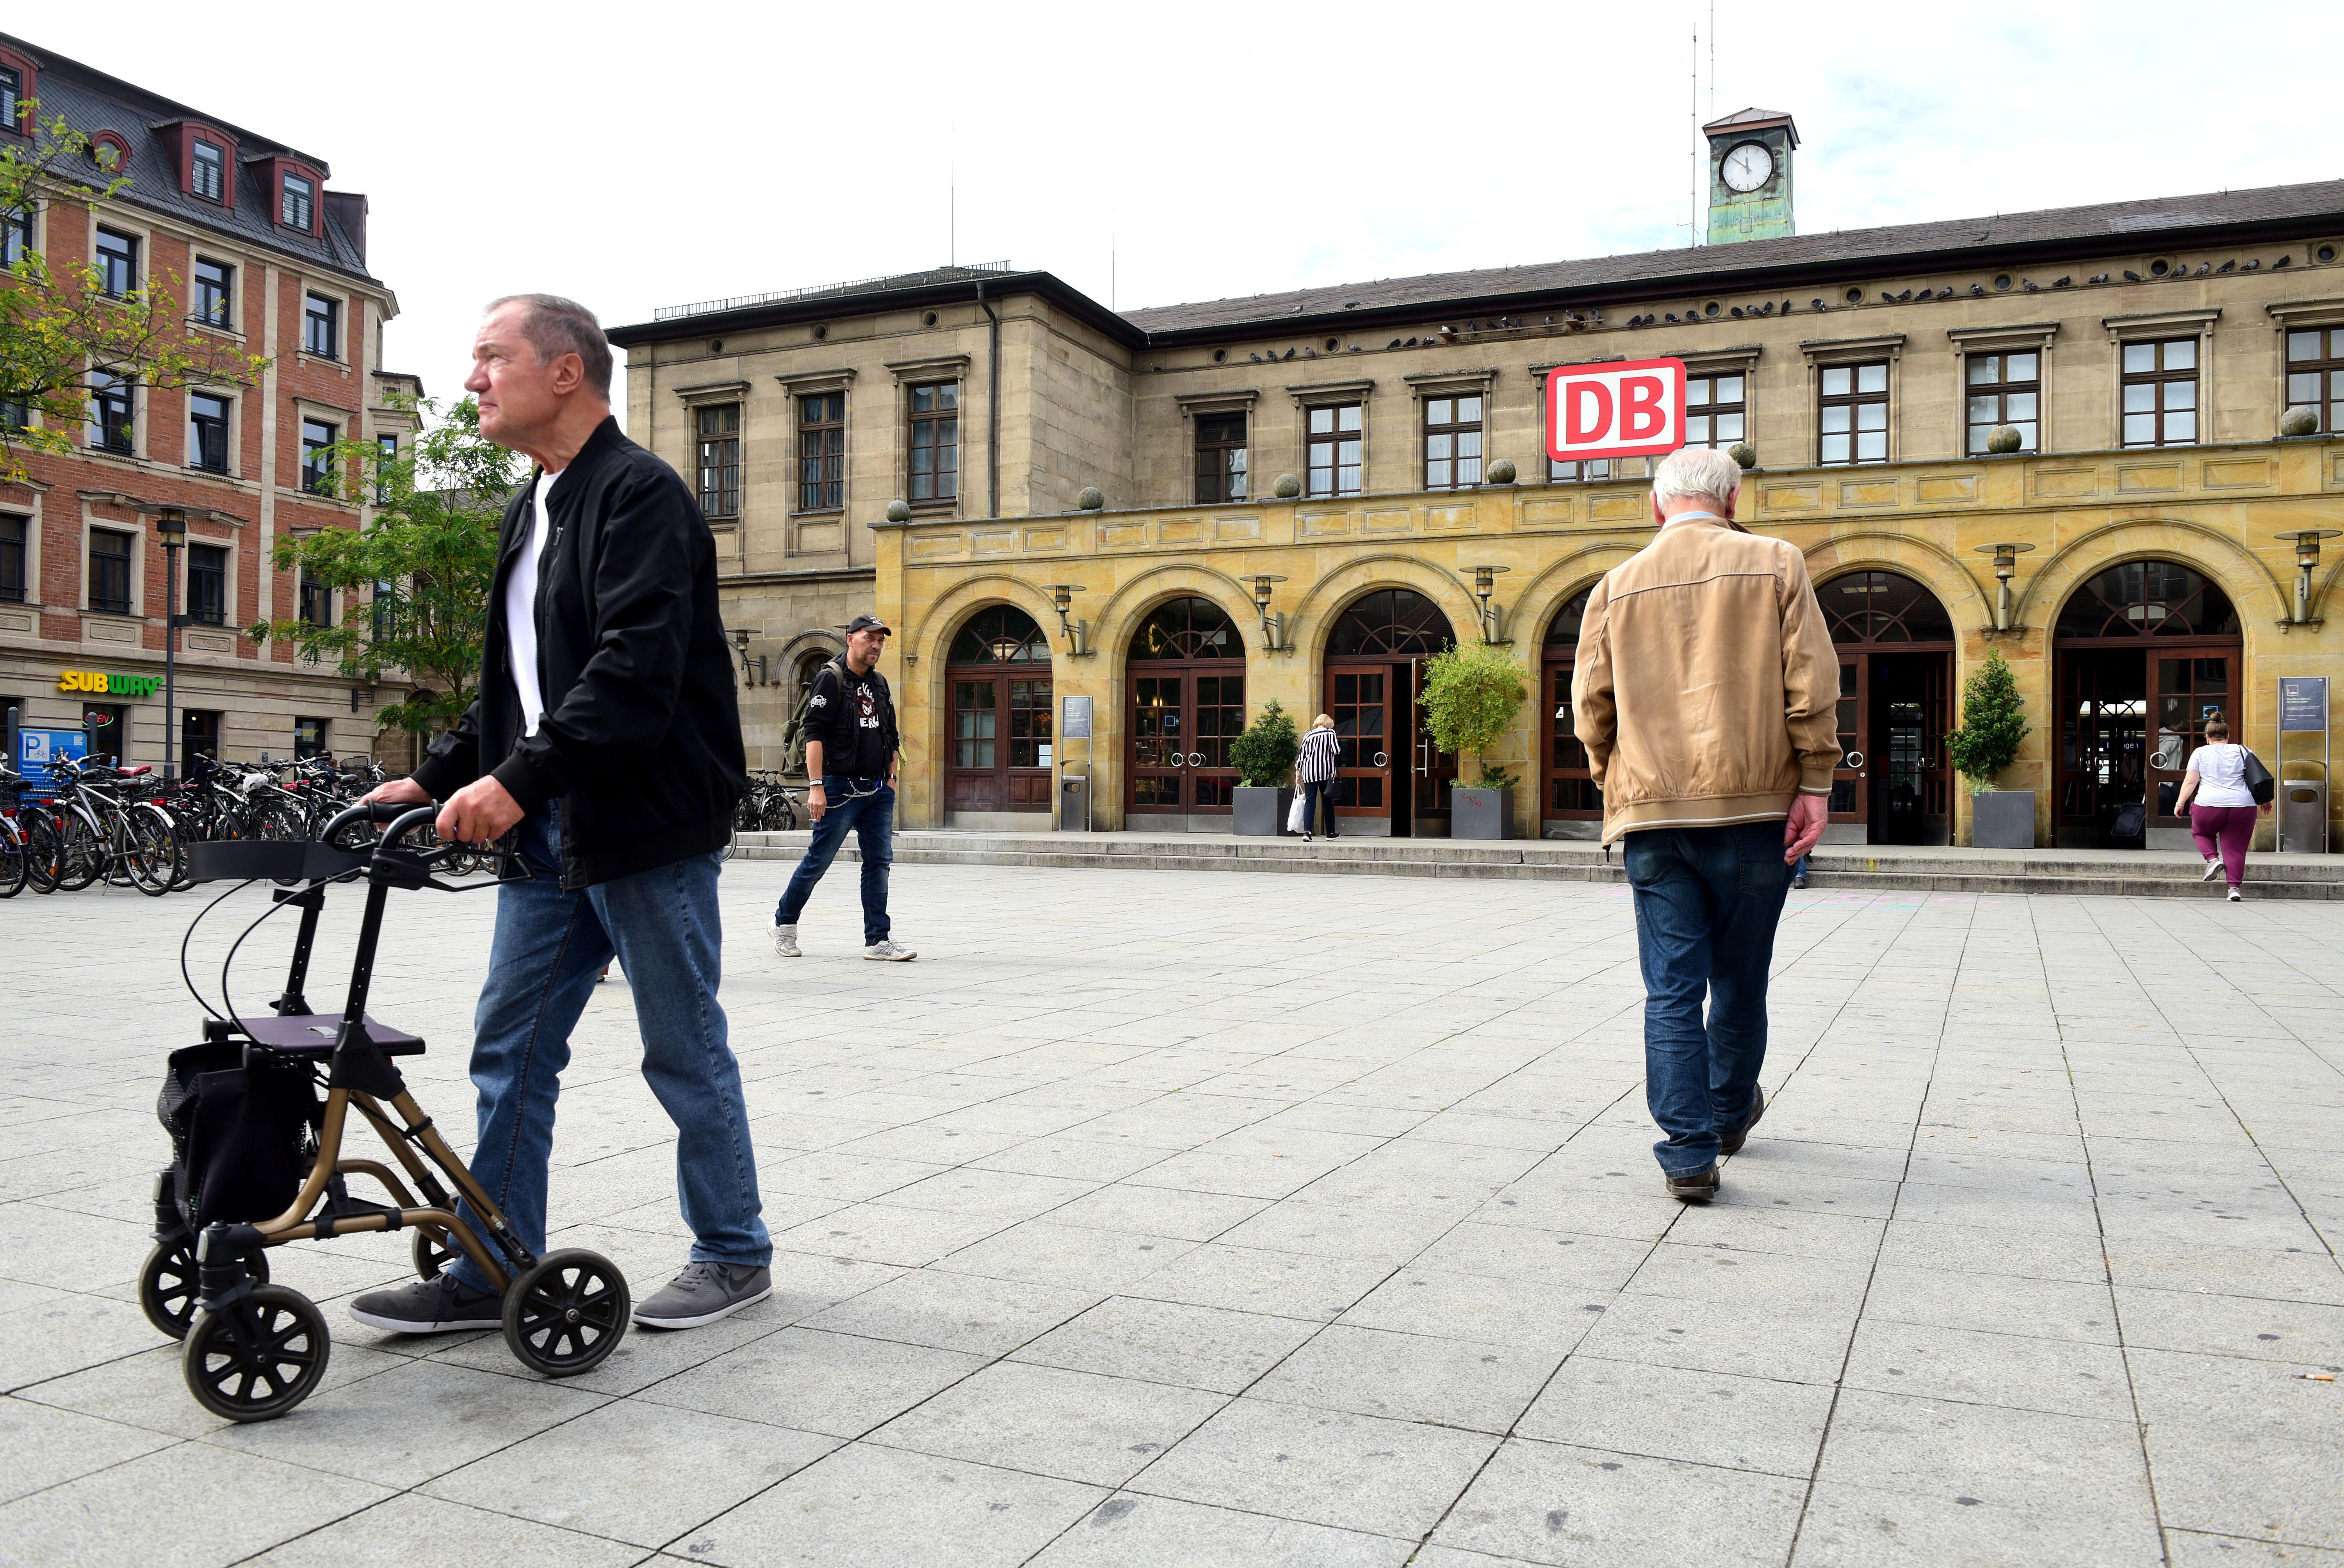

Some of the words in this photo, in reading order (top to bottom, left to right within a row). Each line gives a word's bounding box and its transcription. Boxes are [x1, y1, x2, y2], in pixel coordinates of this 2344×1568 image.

[1566, 376, 1666, 444] DB
[57, 671, 164, 696] SUBWAY
[26, 736, 41, 758] P
